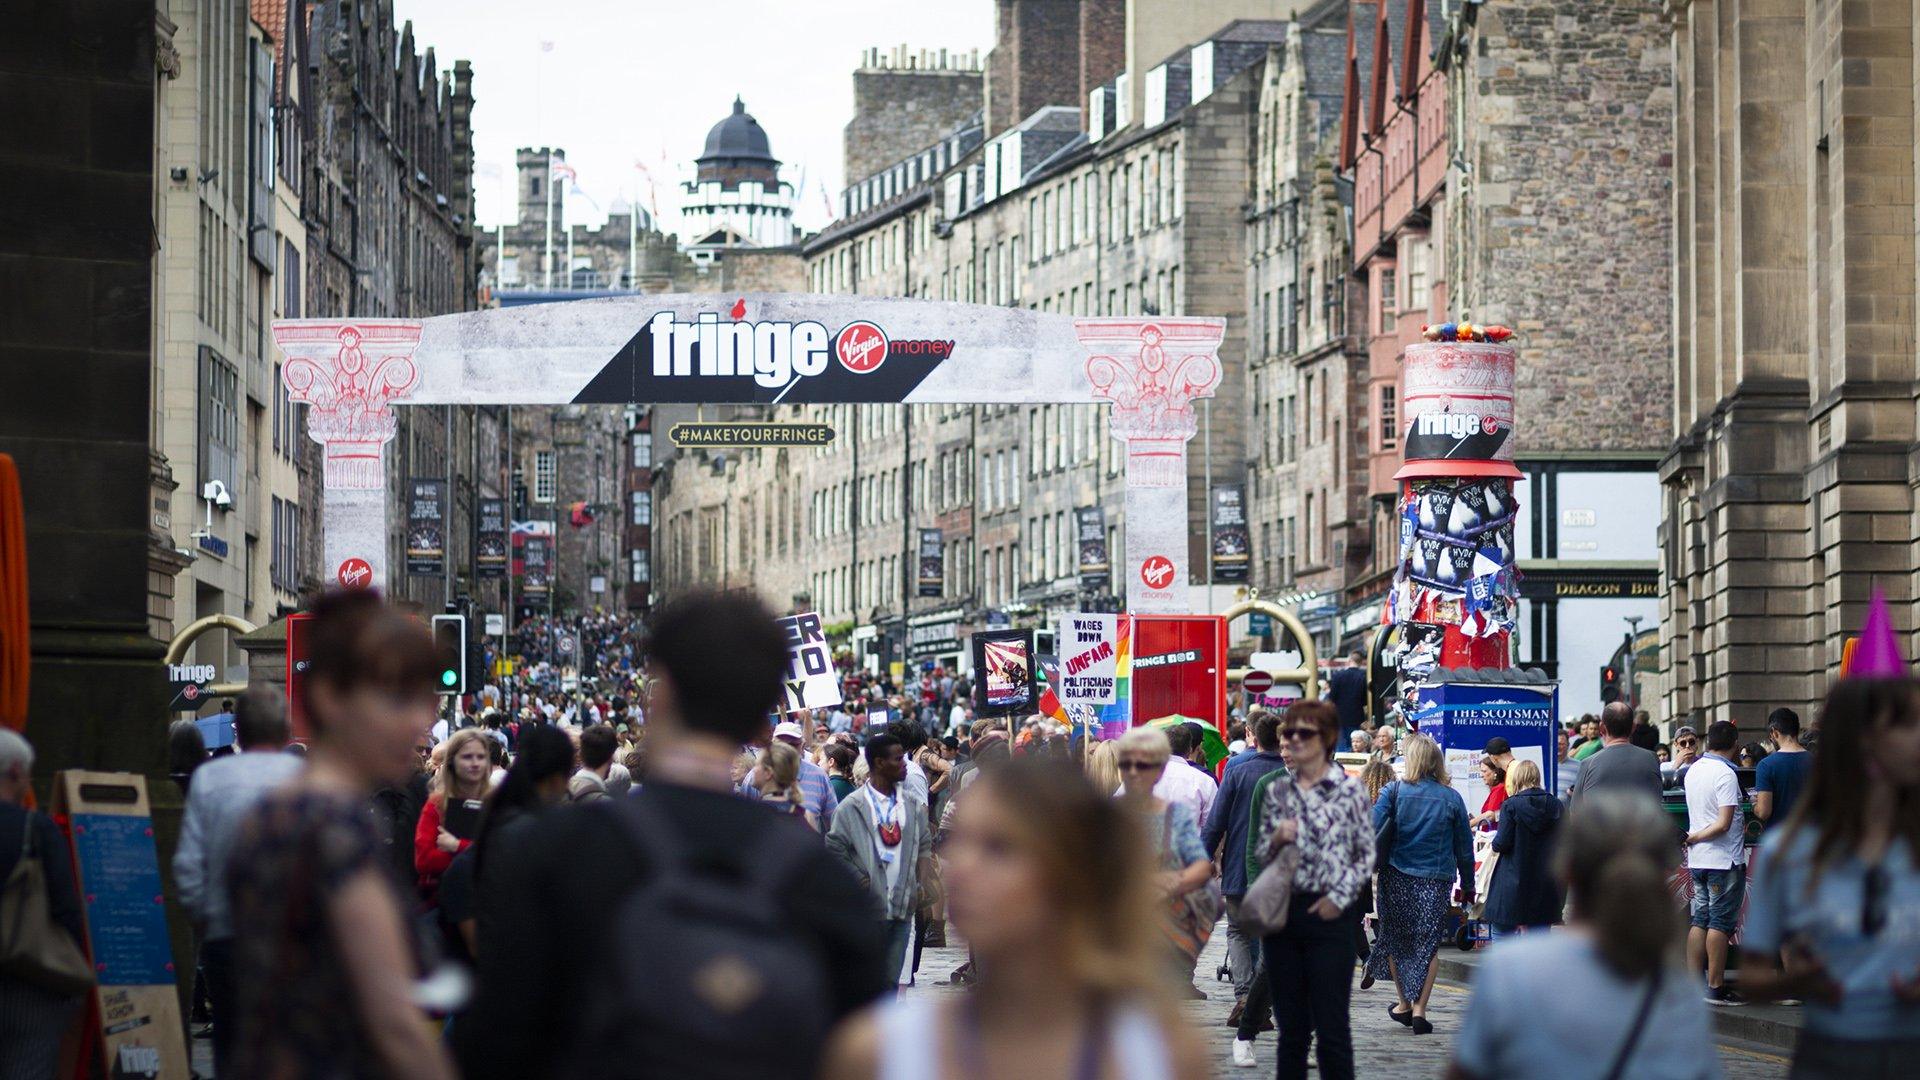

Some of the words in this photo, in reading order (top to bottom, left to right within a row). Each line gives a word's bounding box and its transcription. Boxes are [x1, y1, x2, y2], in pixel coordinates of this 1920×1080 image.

[650, 311, 829, 388] fringe
[842, 329, 883, 365] Virgin
[891, 340, 955, 359] money
[1418, 410, 1480, 439] fringe
[679, 429, 826, 443] #MAKEYOURFRINGE
[1432, 494, 1452, 505] HYDE
[1434, 506, 1448, 515] SEEK
[1423, 540, 1441, 550] HYDE
[1425, 552, 1437, 560] SEEK
[1453, 548, 1473, 558] HYDE
[1455, 559, 1469, 568] SEEK
[341, 561, 369, 586] Virgin
[1143, 559, 1173, 585] Virgin
[1556, 583, 1620, 595] DEACON
[1141, 590, 1174, 600] money
[1074, 620, 1103, 631] WAGES
[1077, 632, 1102, 642] DOWN
[786, 646, 827, 680] TO
[1065, 641, 1113, 676] UNFAIR
[1132, 655, 1166, 669] FRINGE
[1063, 677, 1113, 688] POLITICIANS
[1066, 688, 1097, 699] SALARY
[1100, 688, 1111, 698] UP
[1453, 709, 1479, 718] THE
[1481, 709, 1549, 720] SCOTSMAN
[1469, 718, 1503, 726] FESTIVAL
[1505, 719, 1549, 727] NEWSPAPER
